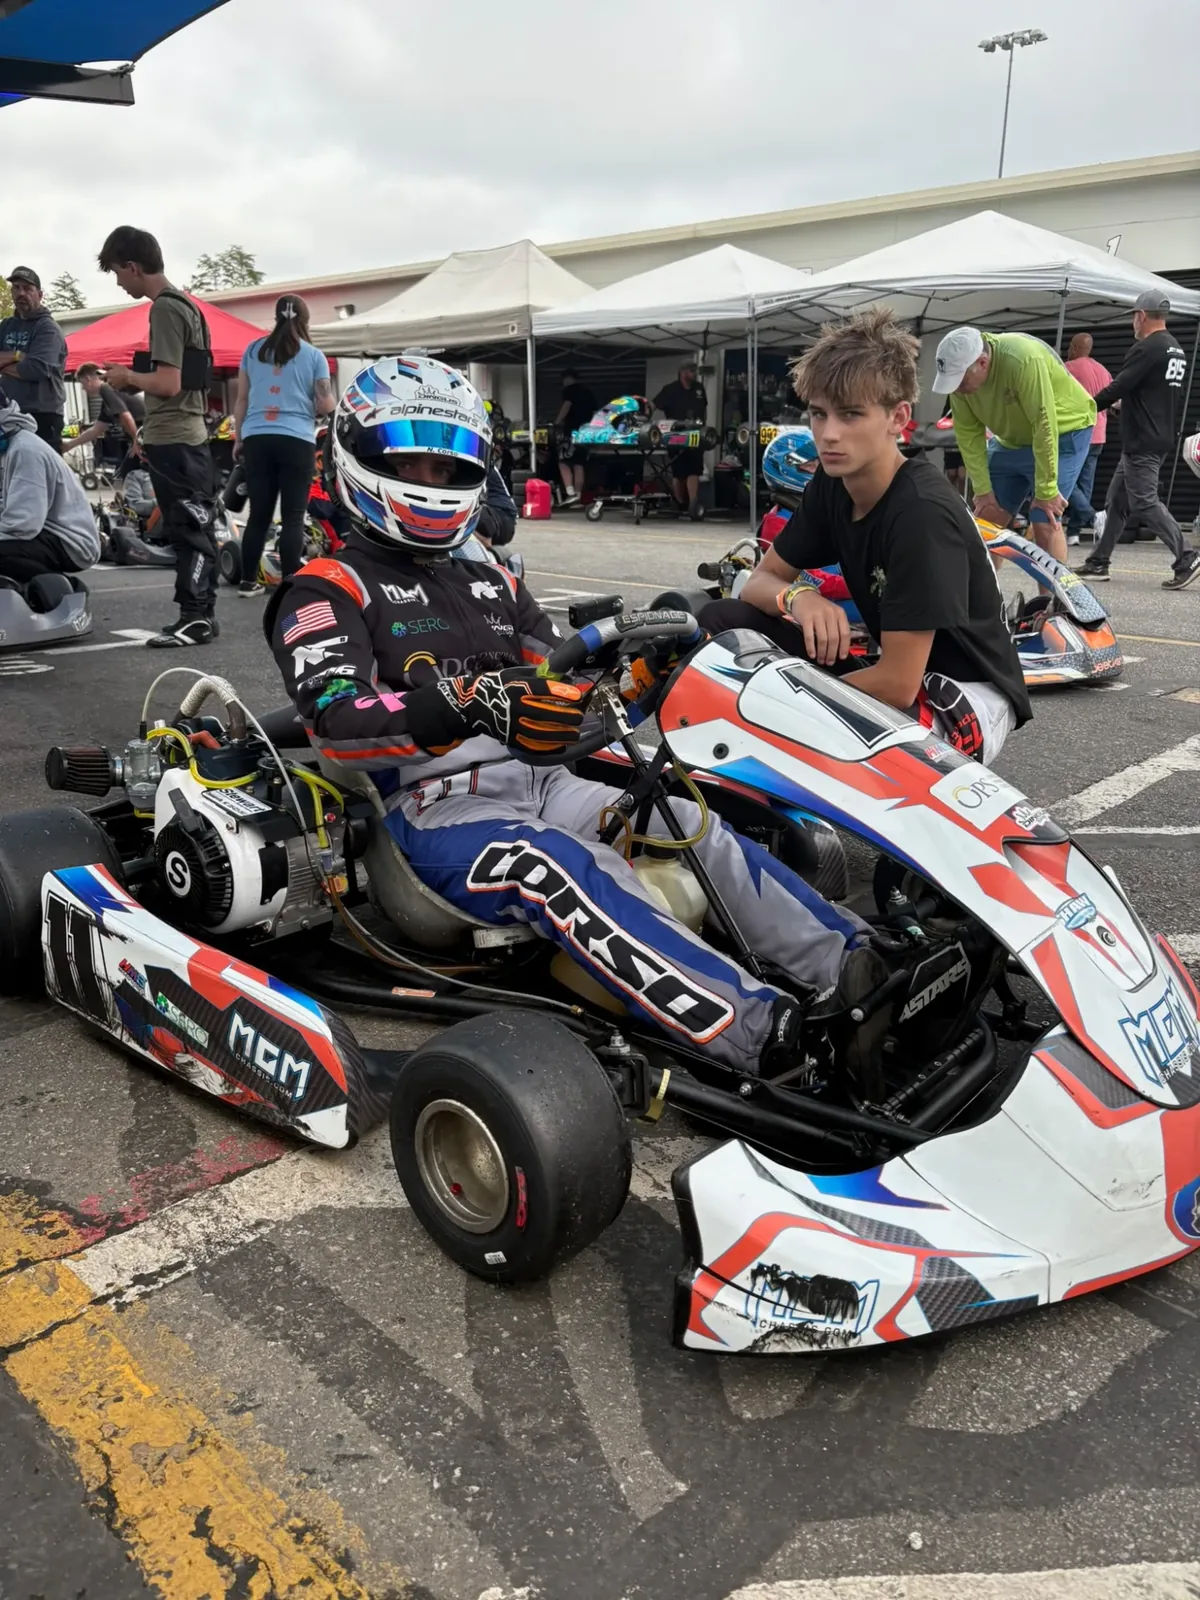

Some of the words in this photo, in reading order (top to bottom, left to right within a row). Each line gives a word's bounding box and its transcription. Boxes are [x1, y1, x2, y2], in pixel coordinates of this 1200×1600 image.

[390, 403, 478, 427] alpinestars
[418, 394, 458, 405] DINGUS
[437, 447, 459, 457] Corso
[621, 610, 686, 624] ESPIONAGE
[219, 787, 266, 812] Stewart
[952, 777, 1000, 809] OPS
[168, 856, 188, 889] S
[467, 841, 735, 1042] CORSO
[45, 890, 112, 1028] 11
[899, 957, 971, 1024] ASTARS
[228, 1011, 312, 1100] MGM
[235, 1053, 293, 1098] CHASSIS.COM
